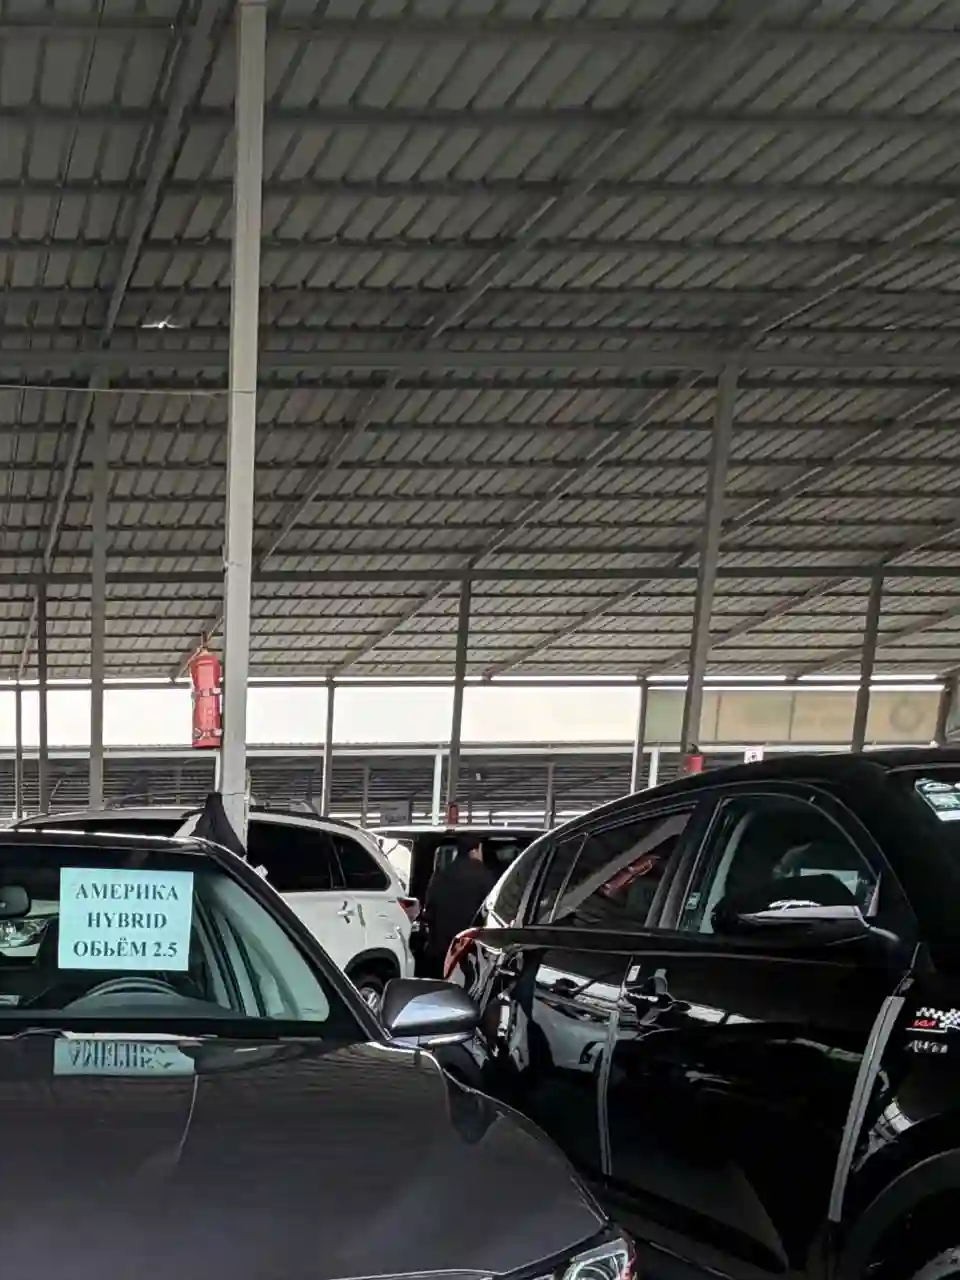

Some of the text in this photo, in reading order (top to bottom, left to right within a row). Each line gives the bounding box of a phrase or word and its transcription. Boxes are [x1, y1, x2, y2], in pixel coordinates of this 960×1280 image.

[75, 883, 179, 901] АМЕРИКА
[87, 911, 168, 929] HYBRID
[153, 941, 178, 958] 2.5
